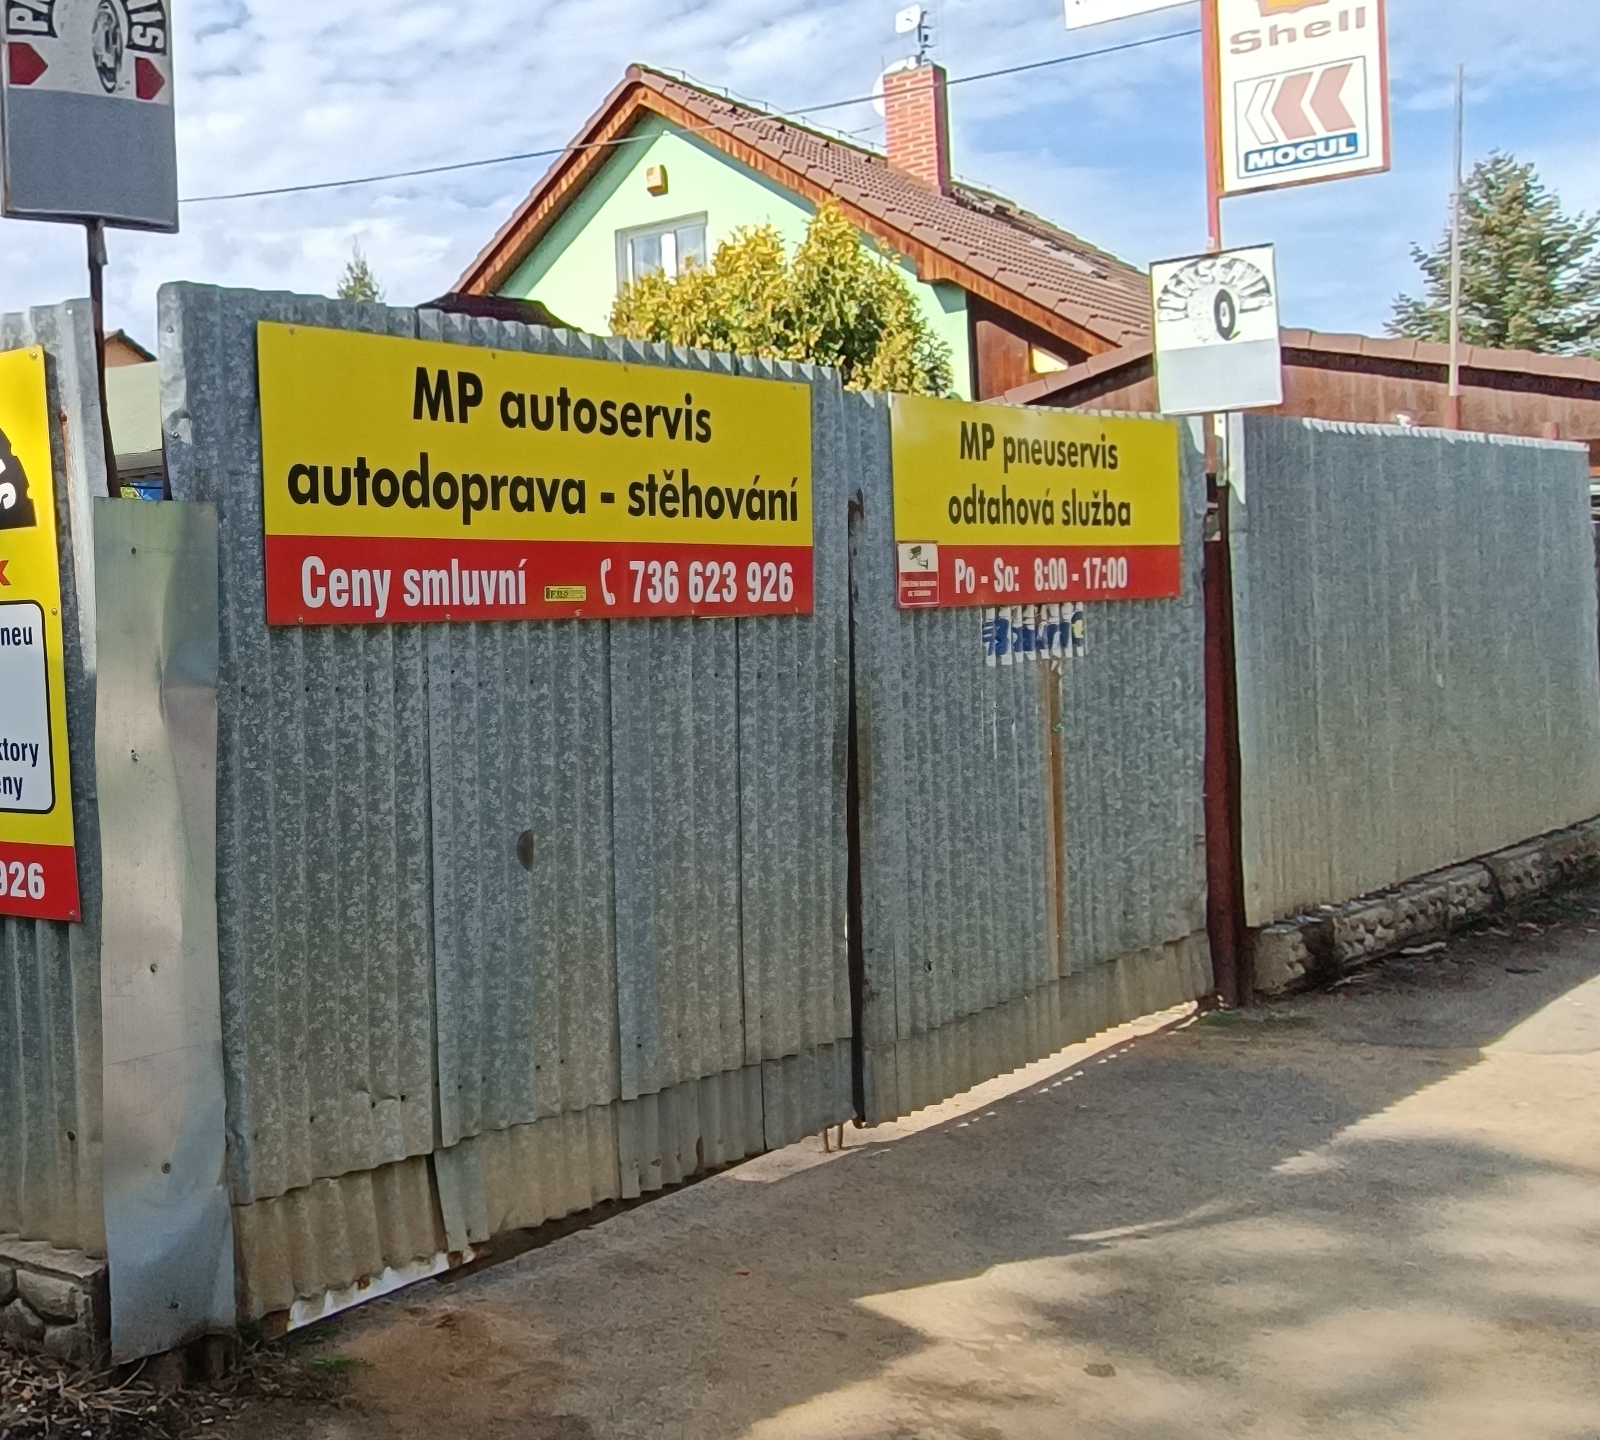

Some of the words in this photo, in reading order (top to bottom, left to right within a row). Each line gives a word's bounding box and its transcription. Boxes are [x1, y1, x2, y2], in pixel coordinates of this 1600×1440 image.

[1230, 6, 1366, 55] Shell
[1247, 136, 1356, 171] MOGUL
[412, 366, 483, 425] MP
[500, 386, 712, 444] autoservis
[959, 420, 995, 462] MP
[1003, 433, 1118, 473] pneuservis
[287, 451, 586, 525] autodoprava
[627, 468, 799, 522] stěhování
[948, 483, 1055, 526] odtahová
[1061, 488, 1131, 527] služba
[301, 555, 392, 618] Ceny
[403, 557, 527, 607] smluvní
[628, 560, 680, 603] 736
[687, 560, 739, 603] 623
[746, 561, 794, 602] 926
[954, 558, 975, 594] Po
[993, 557, 1019, 592] So:
[1034, 557, 1067, 592] 8:00
[1083, 556, 1128, 590] 17:00
